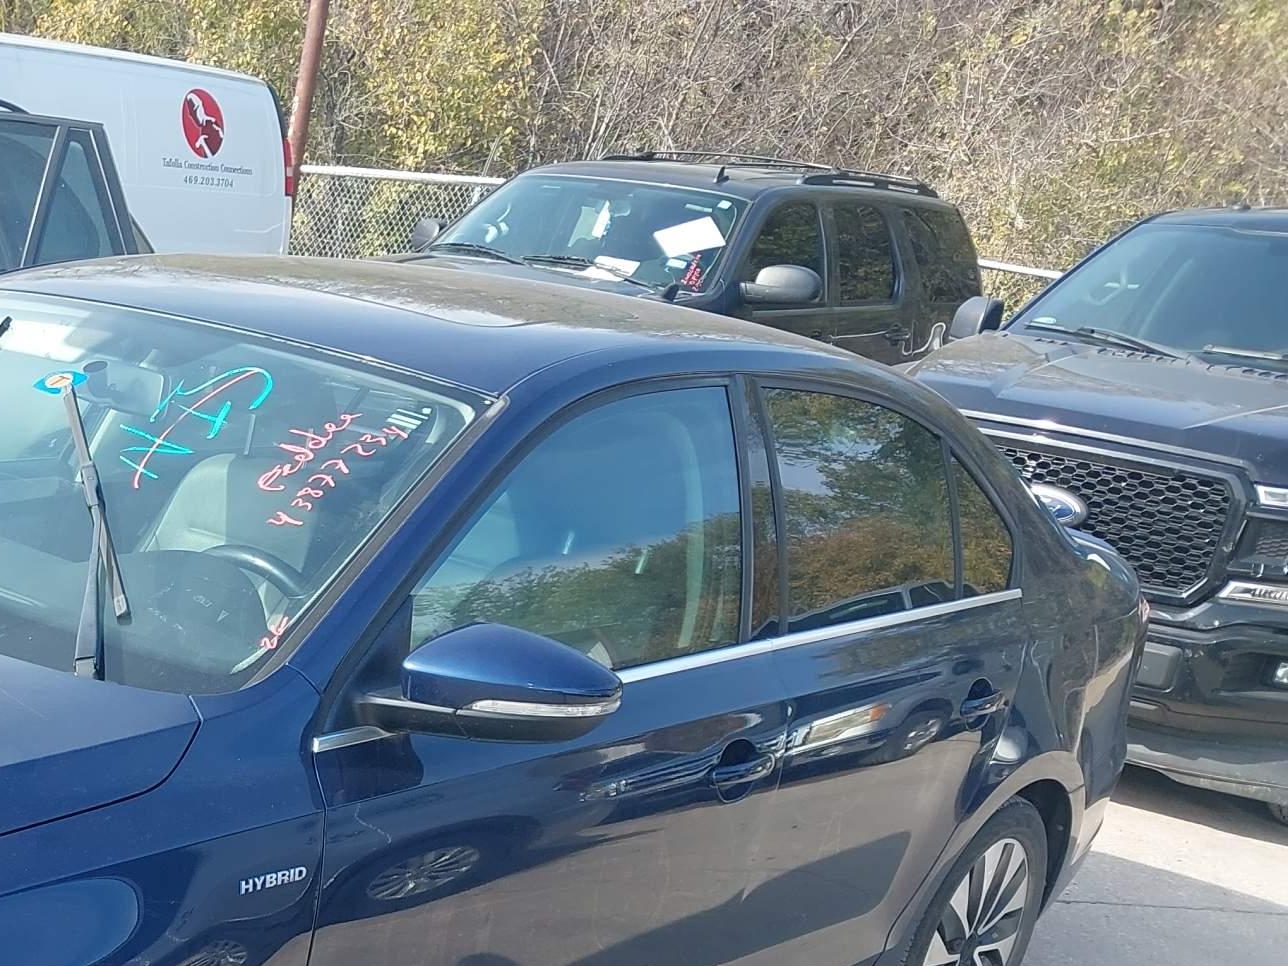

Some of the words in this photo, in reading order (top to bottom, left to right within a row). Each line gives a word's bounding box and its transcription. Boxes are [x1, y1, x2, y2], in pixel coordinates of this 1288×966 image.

[184, 160, 219, 171] Construction
[220, 163, 252, 174] Connections
[239, 866, 308, 895] HYBRID
